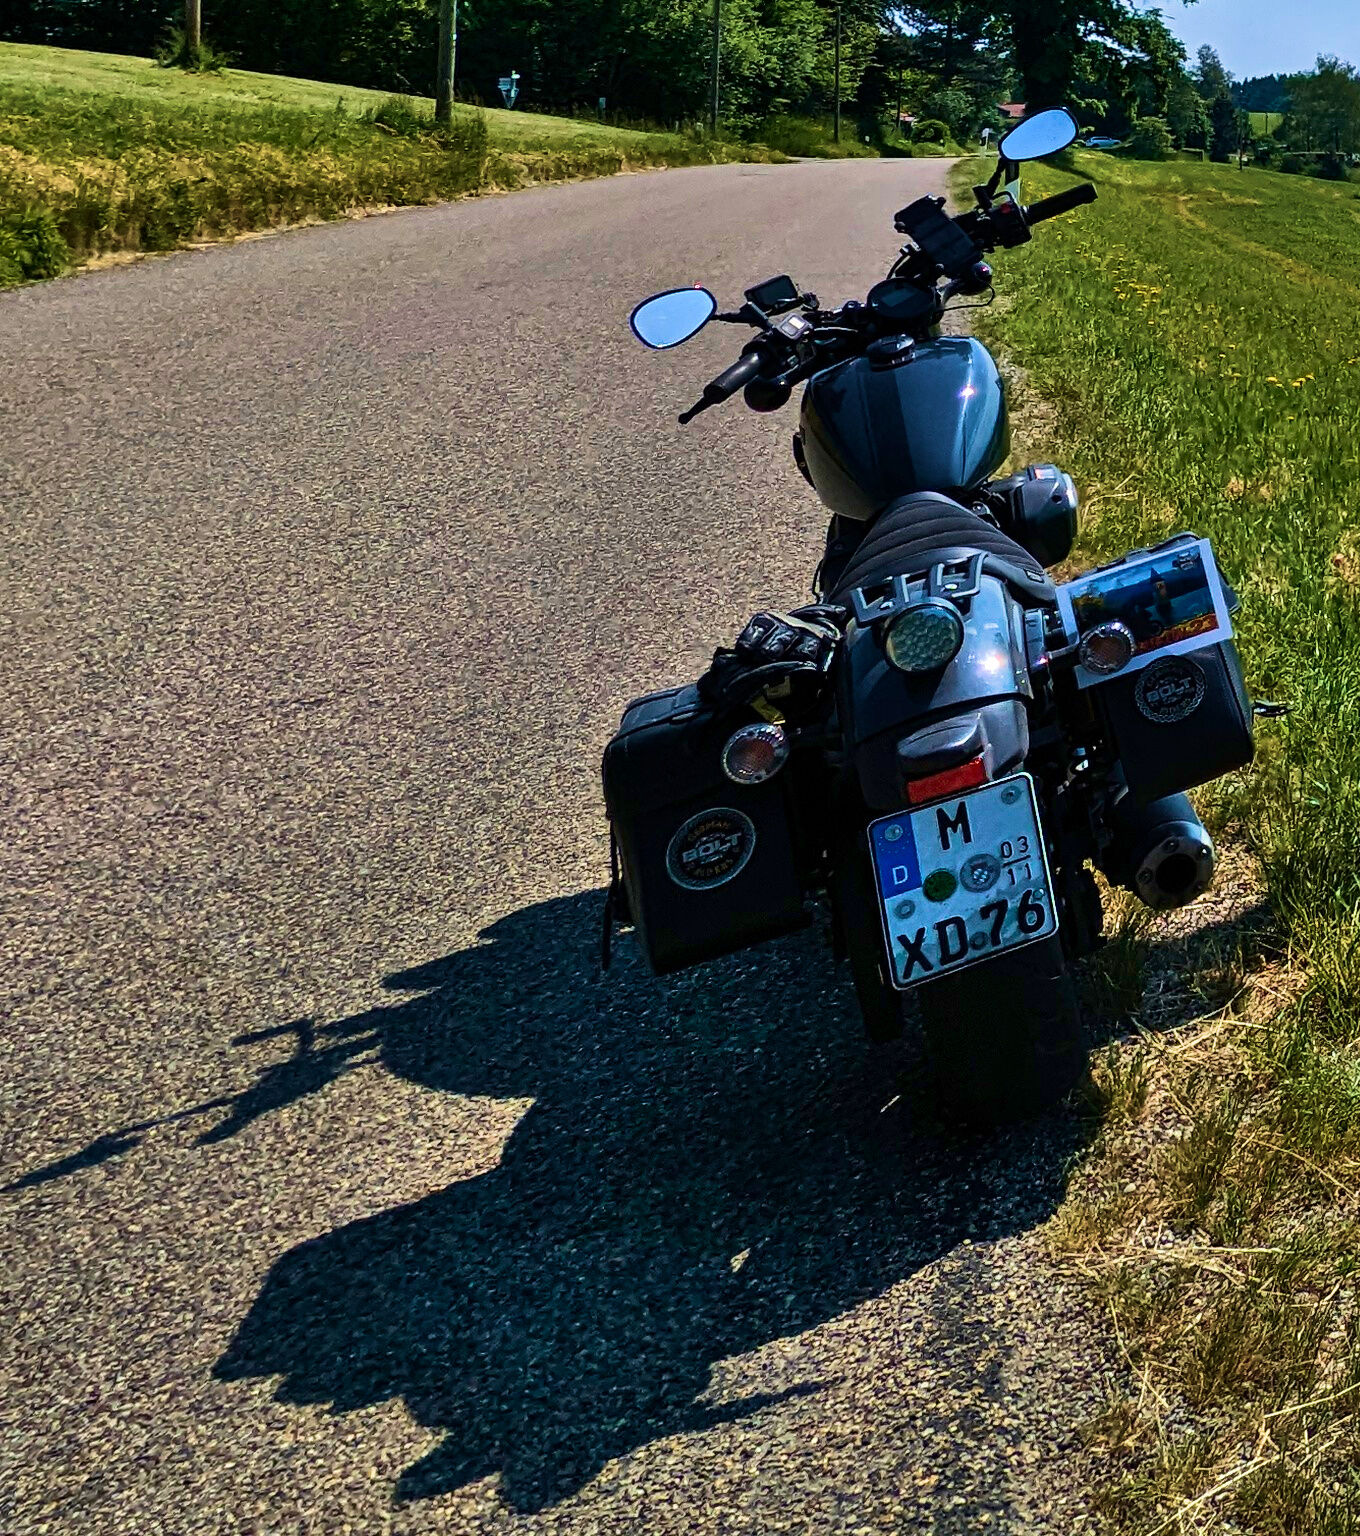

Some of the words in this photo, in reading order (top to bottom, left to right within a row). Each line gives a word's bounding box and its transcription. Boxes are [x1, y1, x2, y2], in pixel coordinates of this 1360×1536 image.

[1145, 676, 1191, 703] BOLT
[936, 801, 972, 851] M
[682, 832, 742, 863] BOLT
[1001, 835, 1029, 858] 03
[892, 865, 909, 885] D
[1007, 862, 1032, 885] 11
[896, 916, 969, 980] XD
[979, 889, 1045, 947] 76
